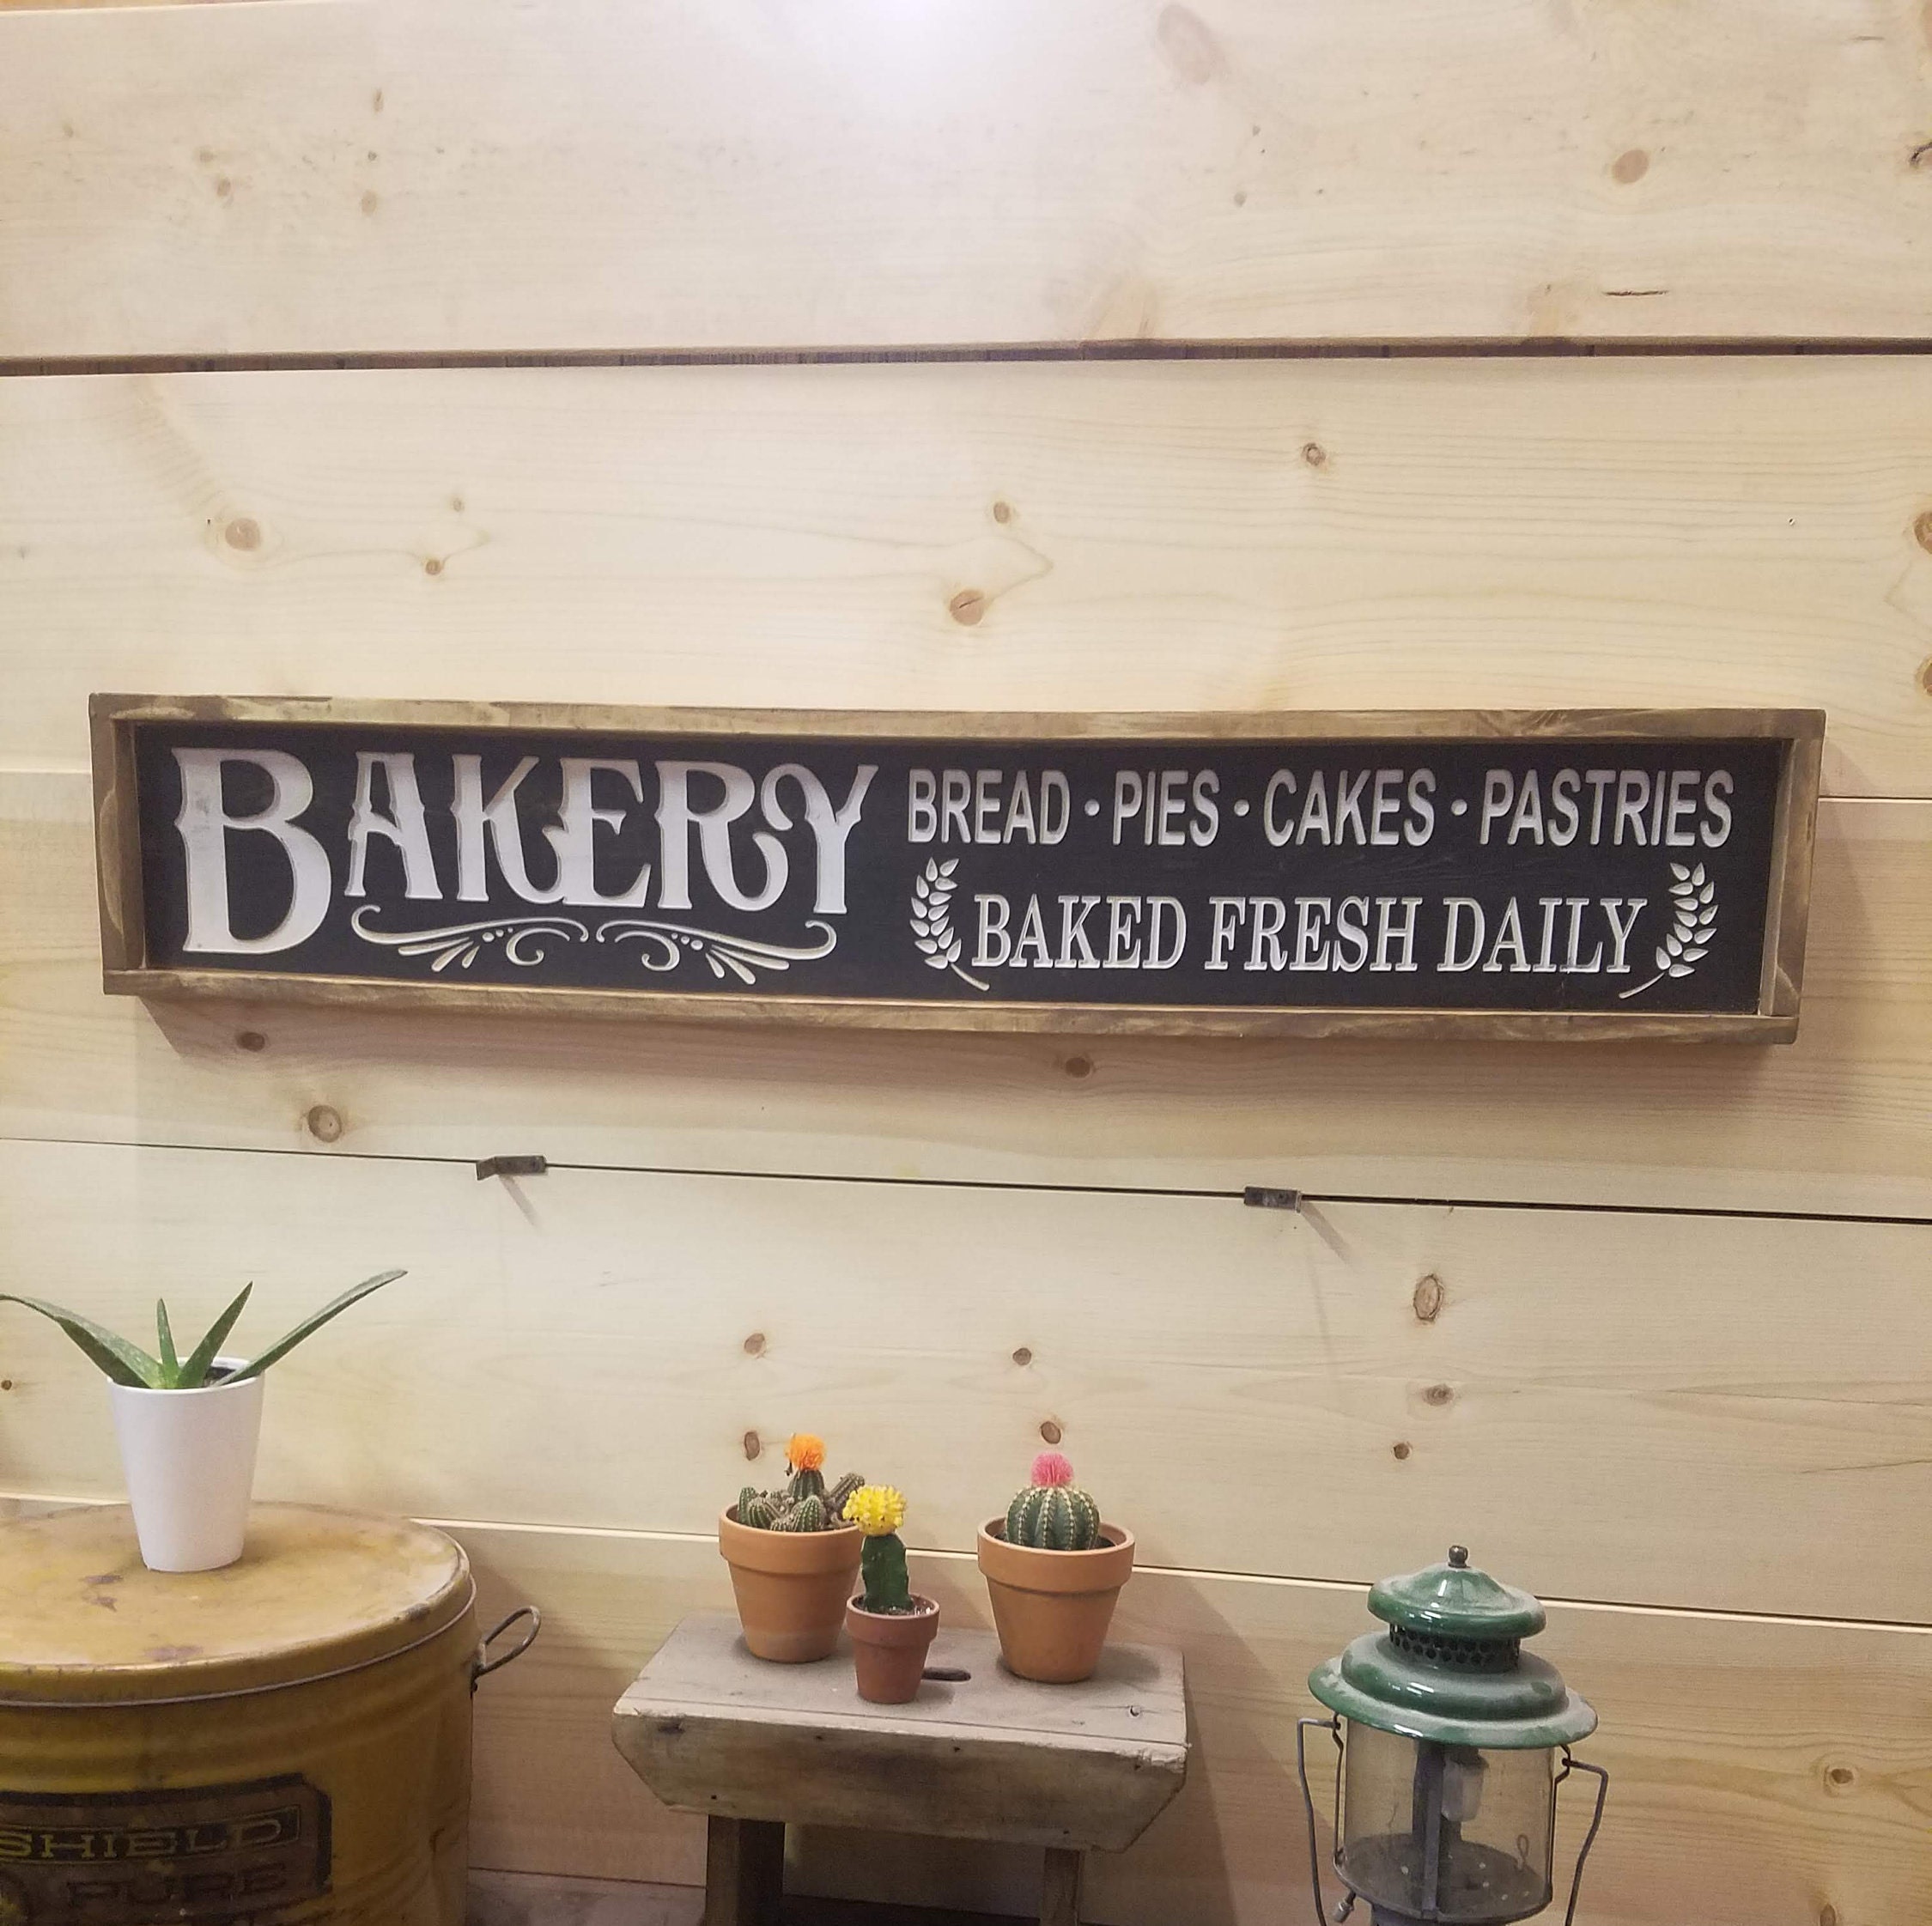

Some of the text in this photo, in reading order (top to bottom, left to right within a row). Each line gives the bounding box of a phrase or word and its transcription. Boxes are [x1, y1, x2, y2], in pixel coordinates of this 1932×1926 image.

[907, 769, 1734, 849] BREAD PIES CAKES PASTRIES
[173, 748, 879, 956] BAKERY
[970, 893, 1649, 975] BAKED FRESH DAILY
